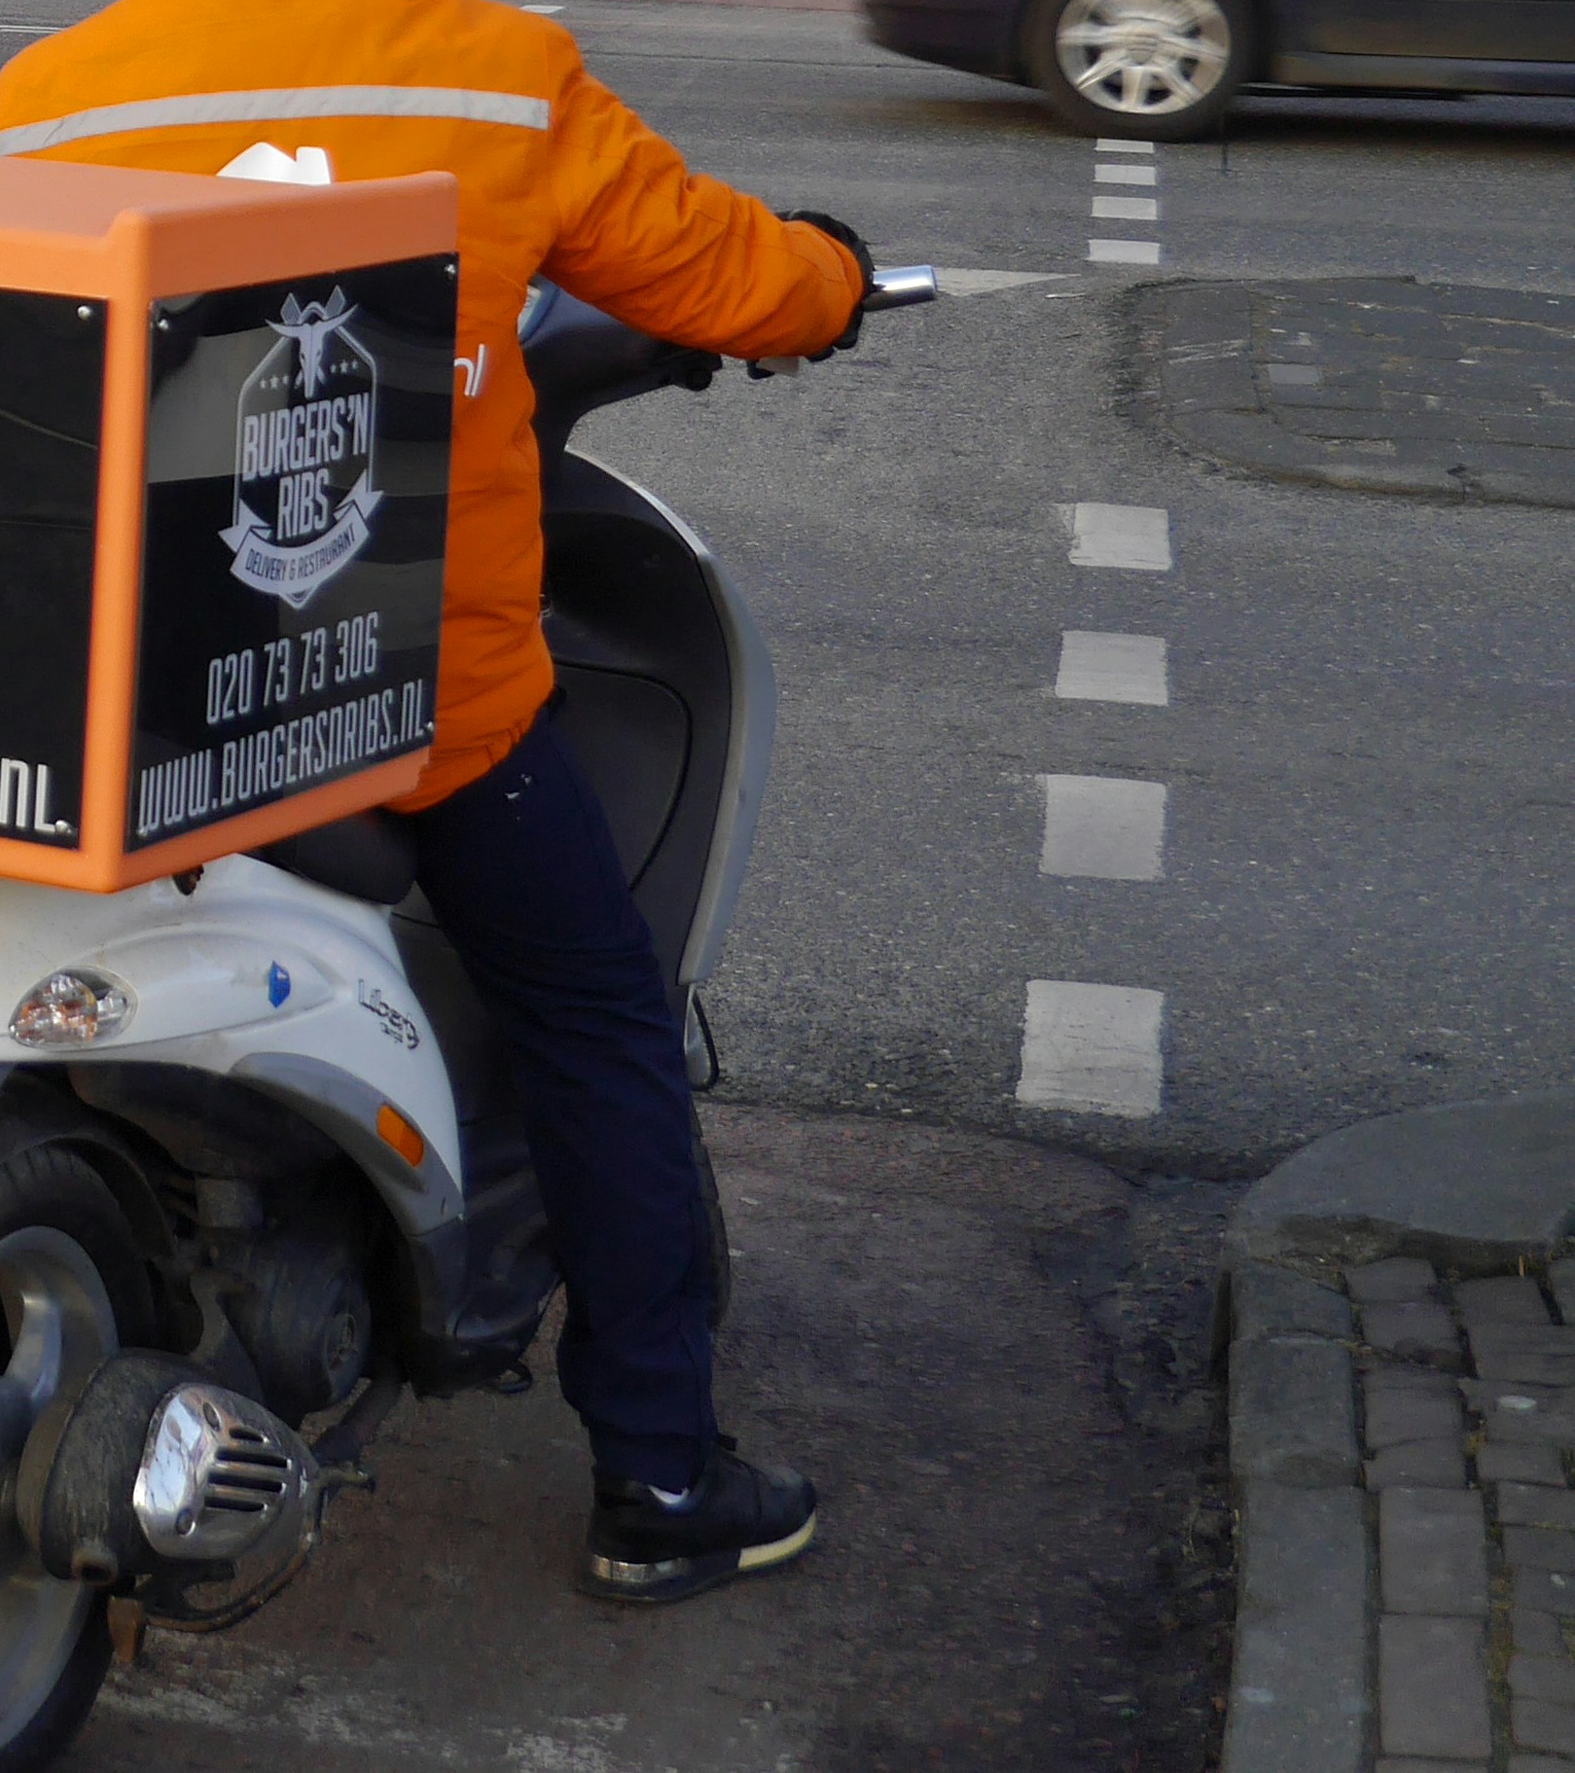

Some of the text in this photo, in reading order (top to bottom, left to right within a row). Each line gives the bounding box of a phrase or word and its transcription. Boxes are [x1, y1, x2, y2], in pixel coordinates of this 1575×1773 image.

[276, 467, 330, 541] RIBS
[244, 548, 288, 581] DELIVERY
[297, 521, 356, 580] RESTAURANT
[206, 610, 379, 725] 020 73 73 306
